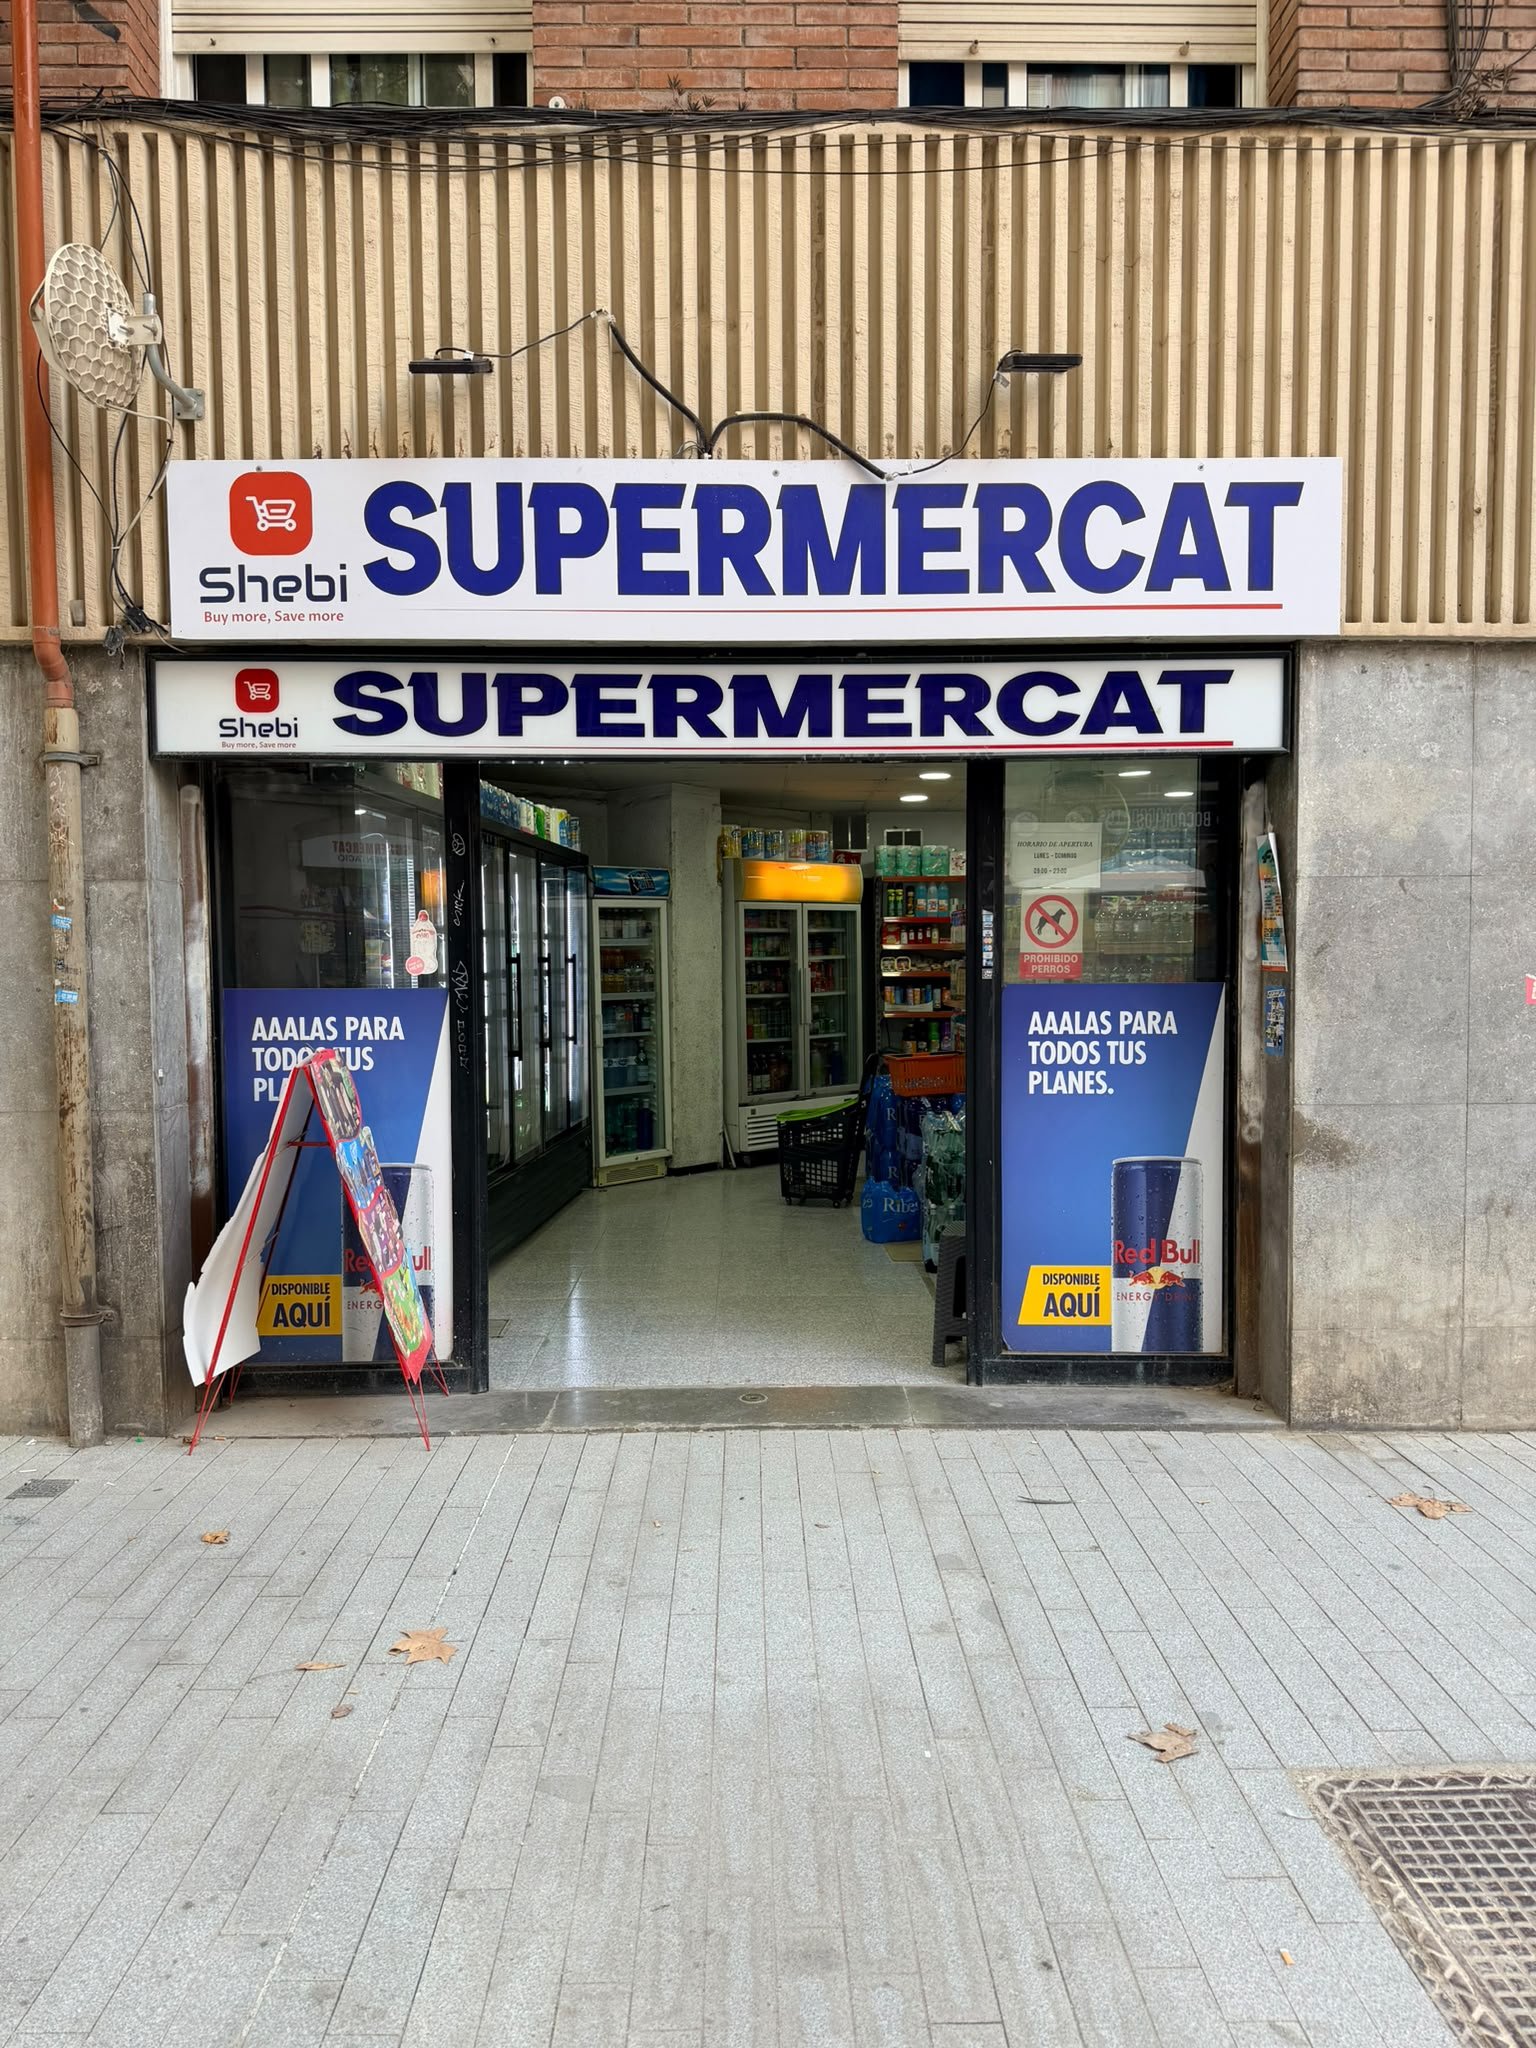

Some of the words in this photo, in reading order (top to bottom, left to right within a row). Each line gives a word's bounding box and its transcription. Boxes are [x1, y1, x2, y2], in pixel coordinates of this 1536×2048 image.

[363, 480, 1304, 596] SUPERMERCAT
[199, 563, 347, 603] Shebi
[204, 611, 229, 625] Buy
[232, 612, 271, 623] more,
[275, 611, 305, 622] Save
[309, 612, 344, 622] more
[333, 669, 1234, 738] SUPERMERCAT
[219, 717, 298, 738] Shebi
[221, 741, 235, 749] Buy
[1023, 954, 1078, 963] PROHIBIDO
[1031, 964, 1071, 974] PERROS
[251, 1016, 338, 1041] AAALAS
[345, 1016, 405, 1040] PARA
[1028, 1010, 1112, 1035] AAALAS
[1119, 1010, 1178, 1035] PARA
[252, 1046, 326, 1071] TOD
[1028, 1040, 1101, 1065] TODOS
[1106, 1040, 1147, 1065] TUS
[1028, 1070, 1114, 1095] PLANES.
[1113, 1239, 1156, 1264] Red
[1161, 1239, 1200, 1264] Bull
[272, 1283, 330, 1295] DISPONIBLE
[1043, 1273, 1100, 1285] DISPONIBLE
[272, 1296, 331, 1327] AQUÍ
[347, 1300, 384, 1309] ENERG
[1043, 1286, 1100, 1317] AQUÍ
